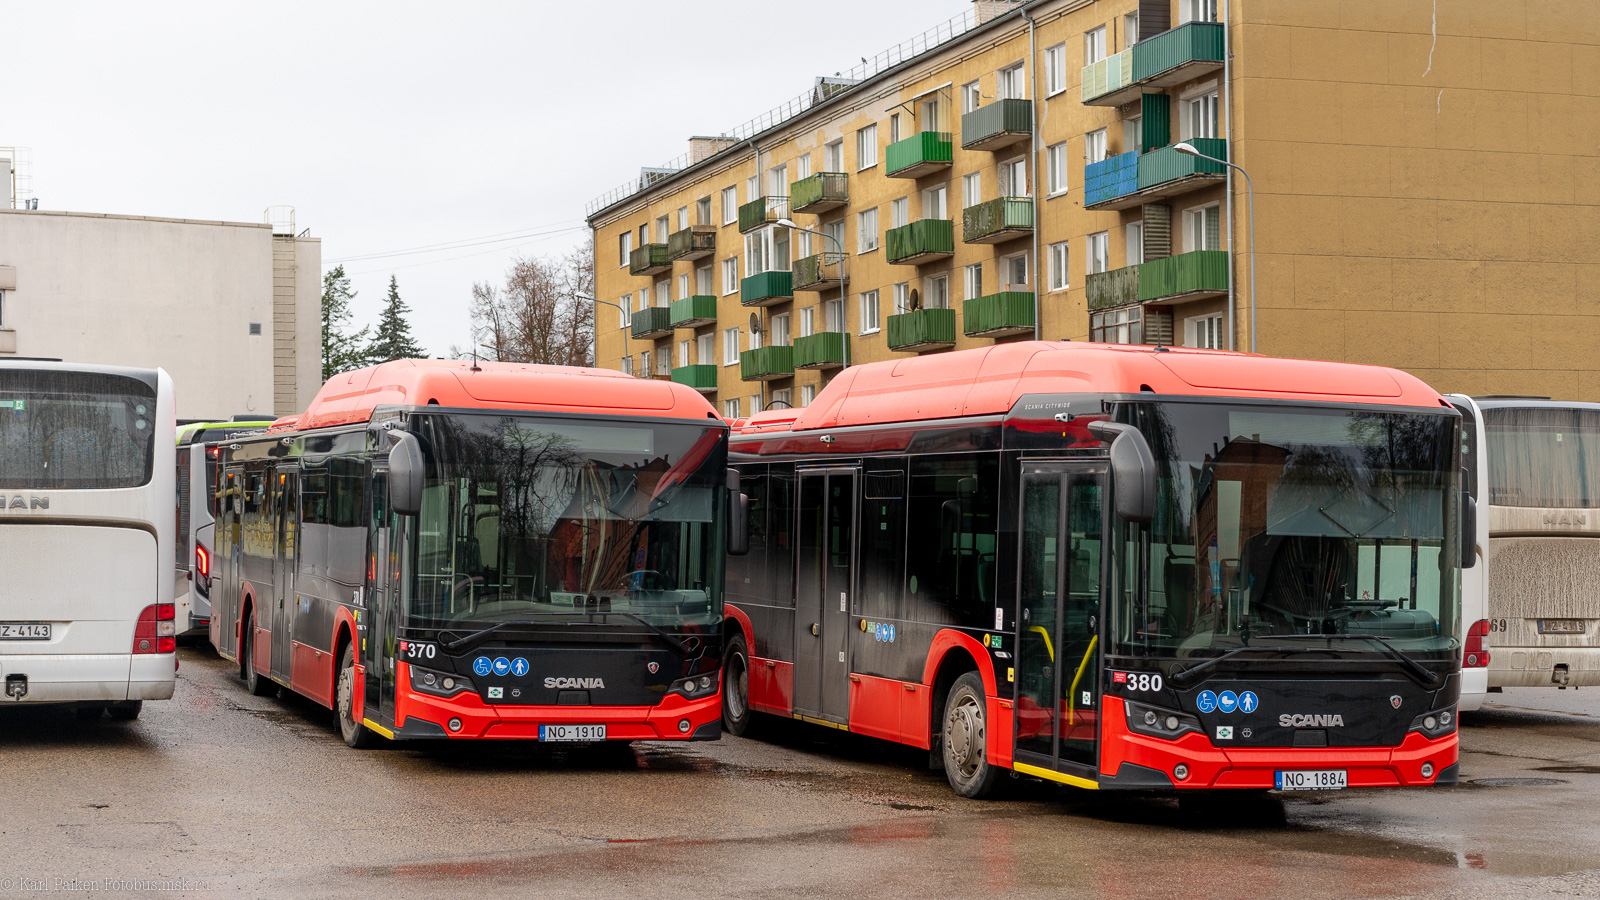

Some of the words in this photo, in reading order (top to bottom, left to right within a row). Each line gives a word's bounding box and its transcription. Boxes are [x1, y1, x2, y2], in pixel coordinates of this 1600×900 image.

[1543, 514, 1586, 526] MAN
[0, 625, 49, 637] Z-4143
[1491, 618, 1507, 633] 69
[407, 642, 436, 659] 370
[543, 677, 605, 689] SCANIA
[1126, 673, 1163, 692] 380
[1278, 714, 1345, 727] SCANIA
[548, 726, 604, 738] NO-1910
[1285, 772, 1345, 786] NO-1884
